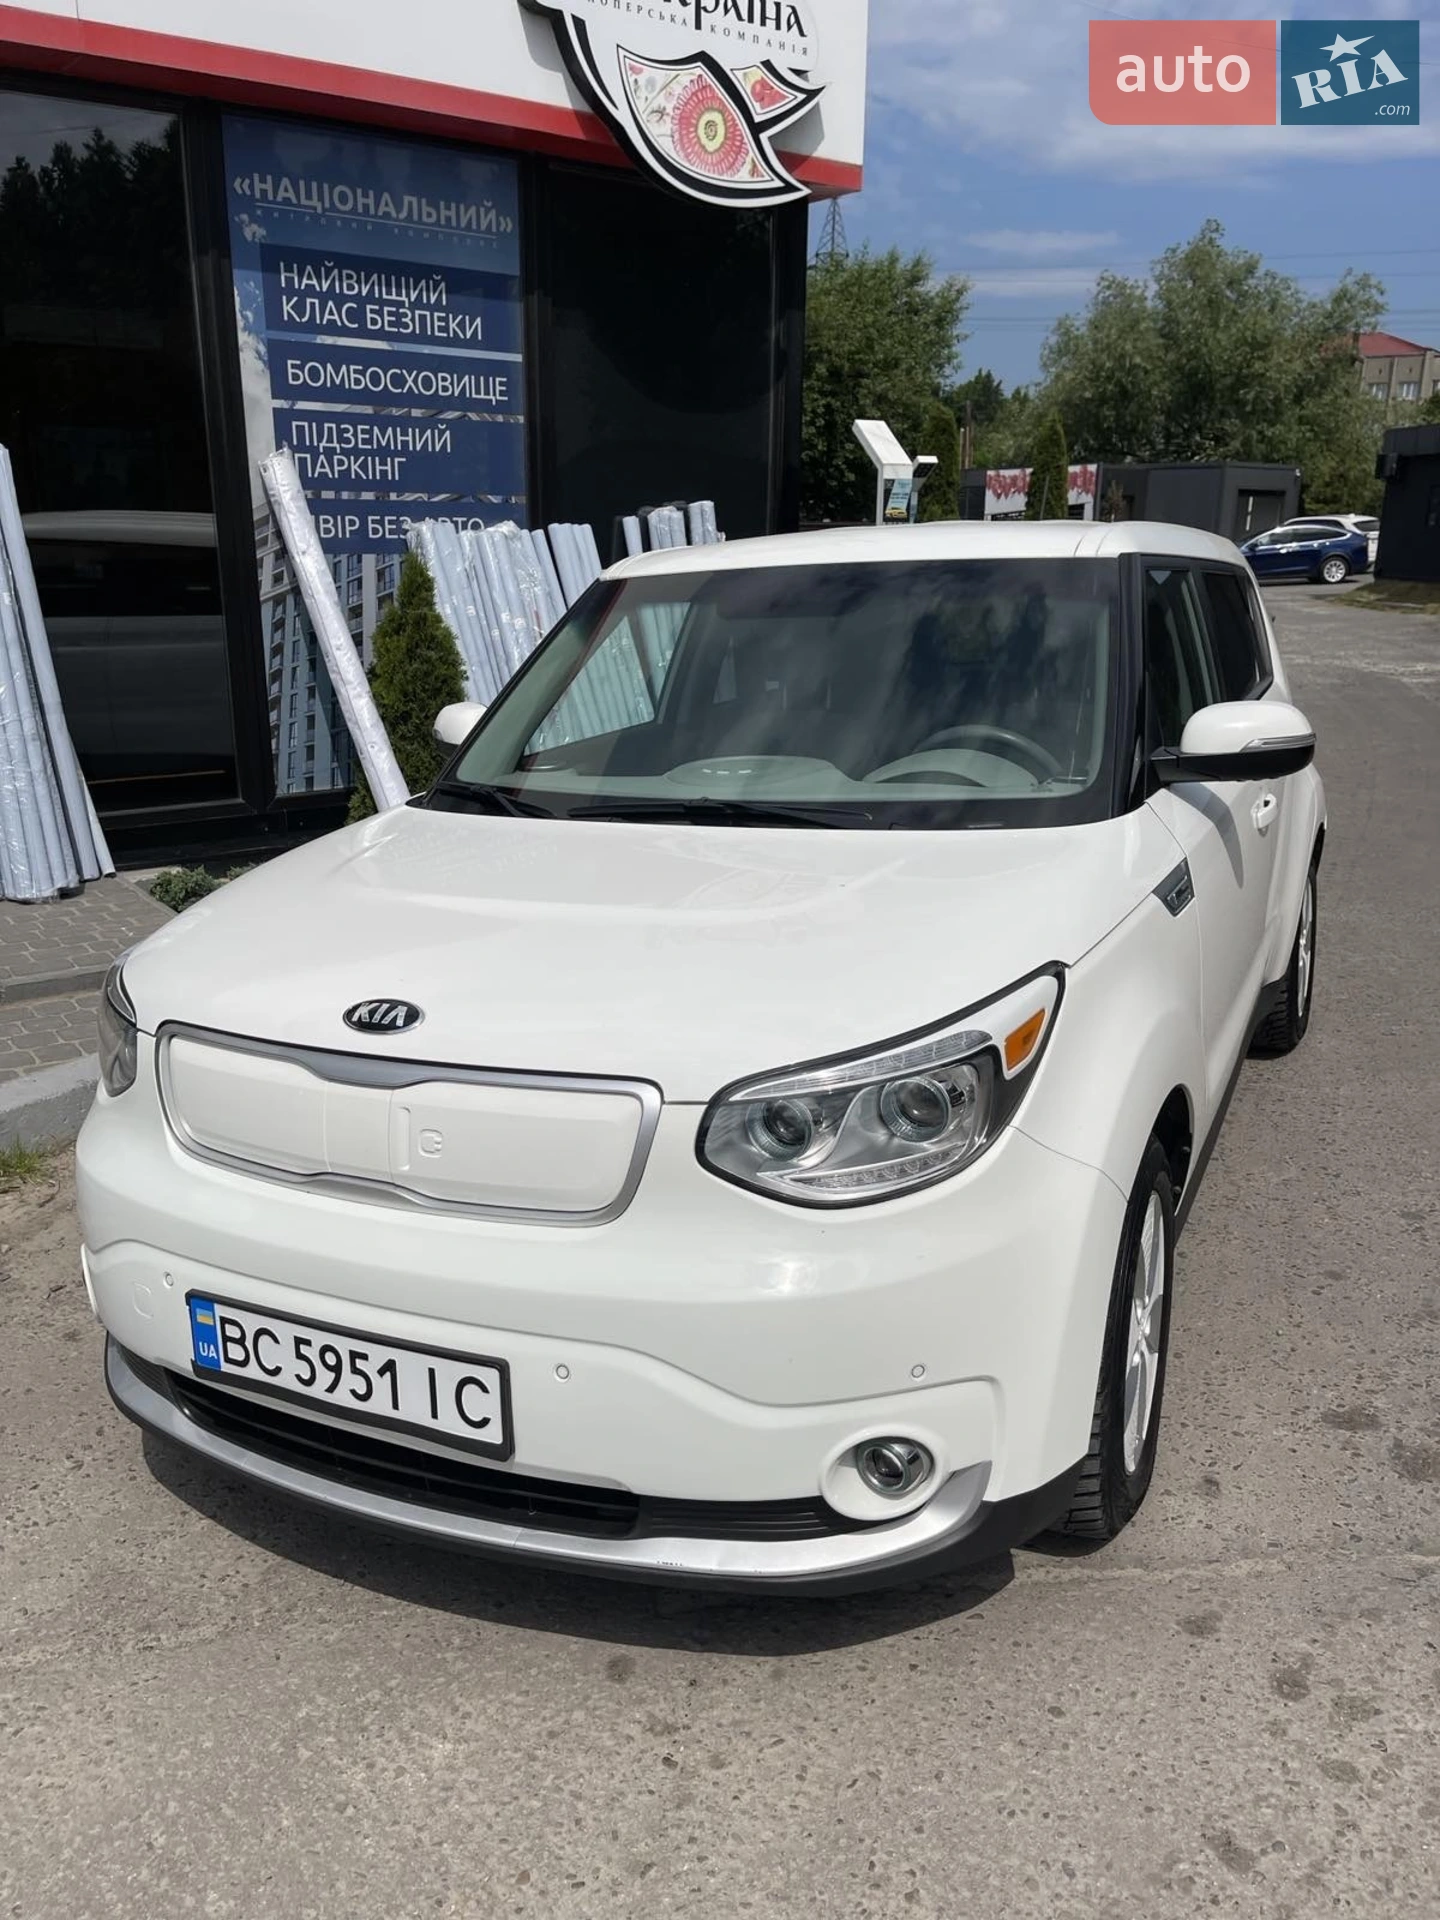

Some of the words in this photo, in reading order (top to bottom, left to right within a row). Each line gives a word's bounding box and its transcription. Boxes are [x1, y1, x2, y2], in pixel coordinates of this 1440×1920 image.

[709, 24, 809, 56] КОМПАНІЯ
[233, 172, 513, 234] «НАЦІОНАЛЬНИЙ»
[279, 261, 447, 306] НАЙВИЩИЙ
[281, 295, 359, 329] КЛАС
[366, 305, 483, 341] БЕЗПЕКИ
[286, 359, 509, 405] БОМБОСХОВИЩЕ
[291, 419, 452, 454] ПІДЗЕМНИЙ
[295, 453, 407, 481] ПАРКІНГ
[311, 514, 360, 539] ВІР
[351, 1001, 408, 1027] KIA
[200, 1342, 218, 1360] UA
[219, 1315, 283, 1377] BC
[294, 1335, 400, 1411] 5951
[427, 1366, 492, 1430] IC
